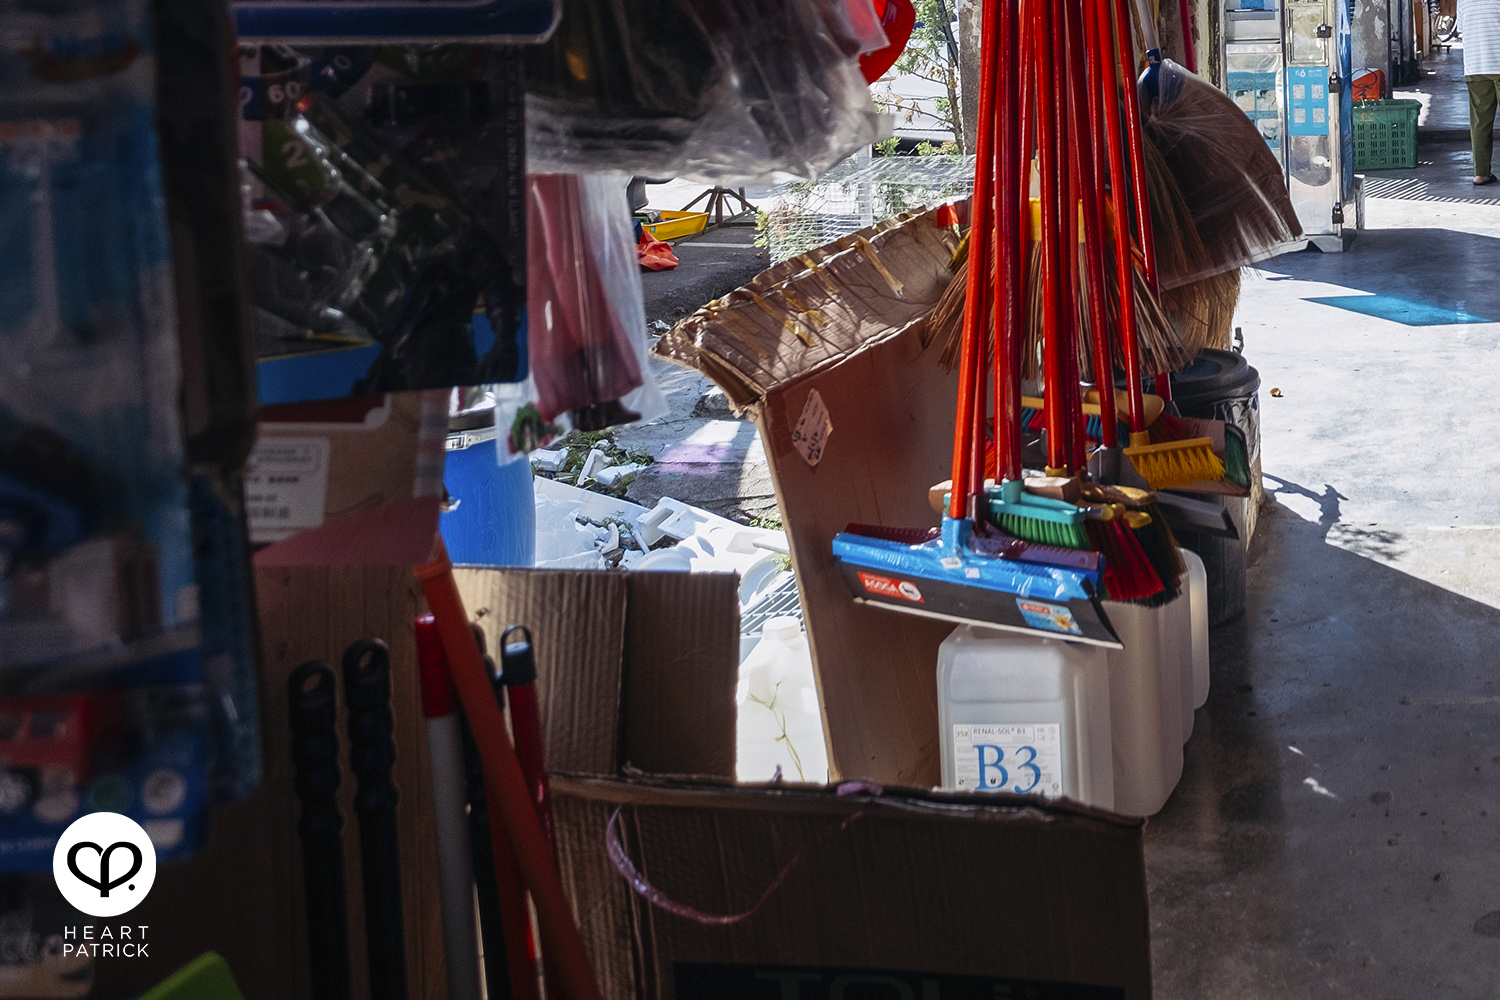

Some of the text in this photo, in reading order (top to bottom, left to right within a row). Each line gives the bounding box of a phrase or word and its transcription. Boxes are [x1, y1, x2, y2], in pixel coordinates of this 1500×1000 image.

[320, 54, 352, 82] 70
[267, 80, 300, 105] 60
[972, 744, 1042, 795] B3
